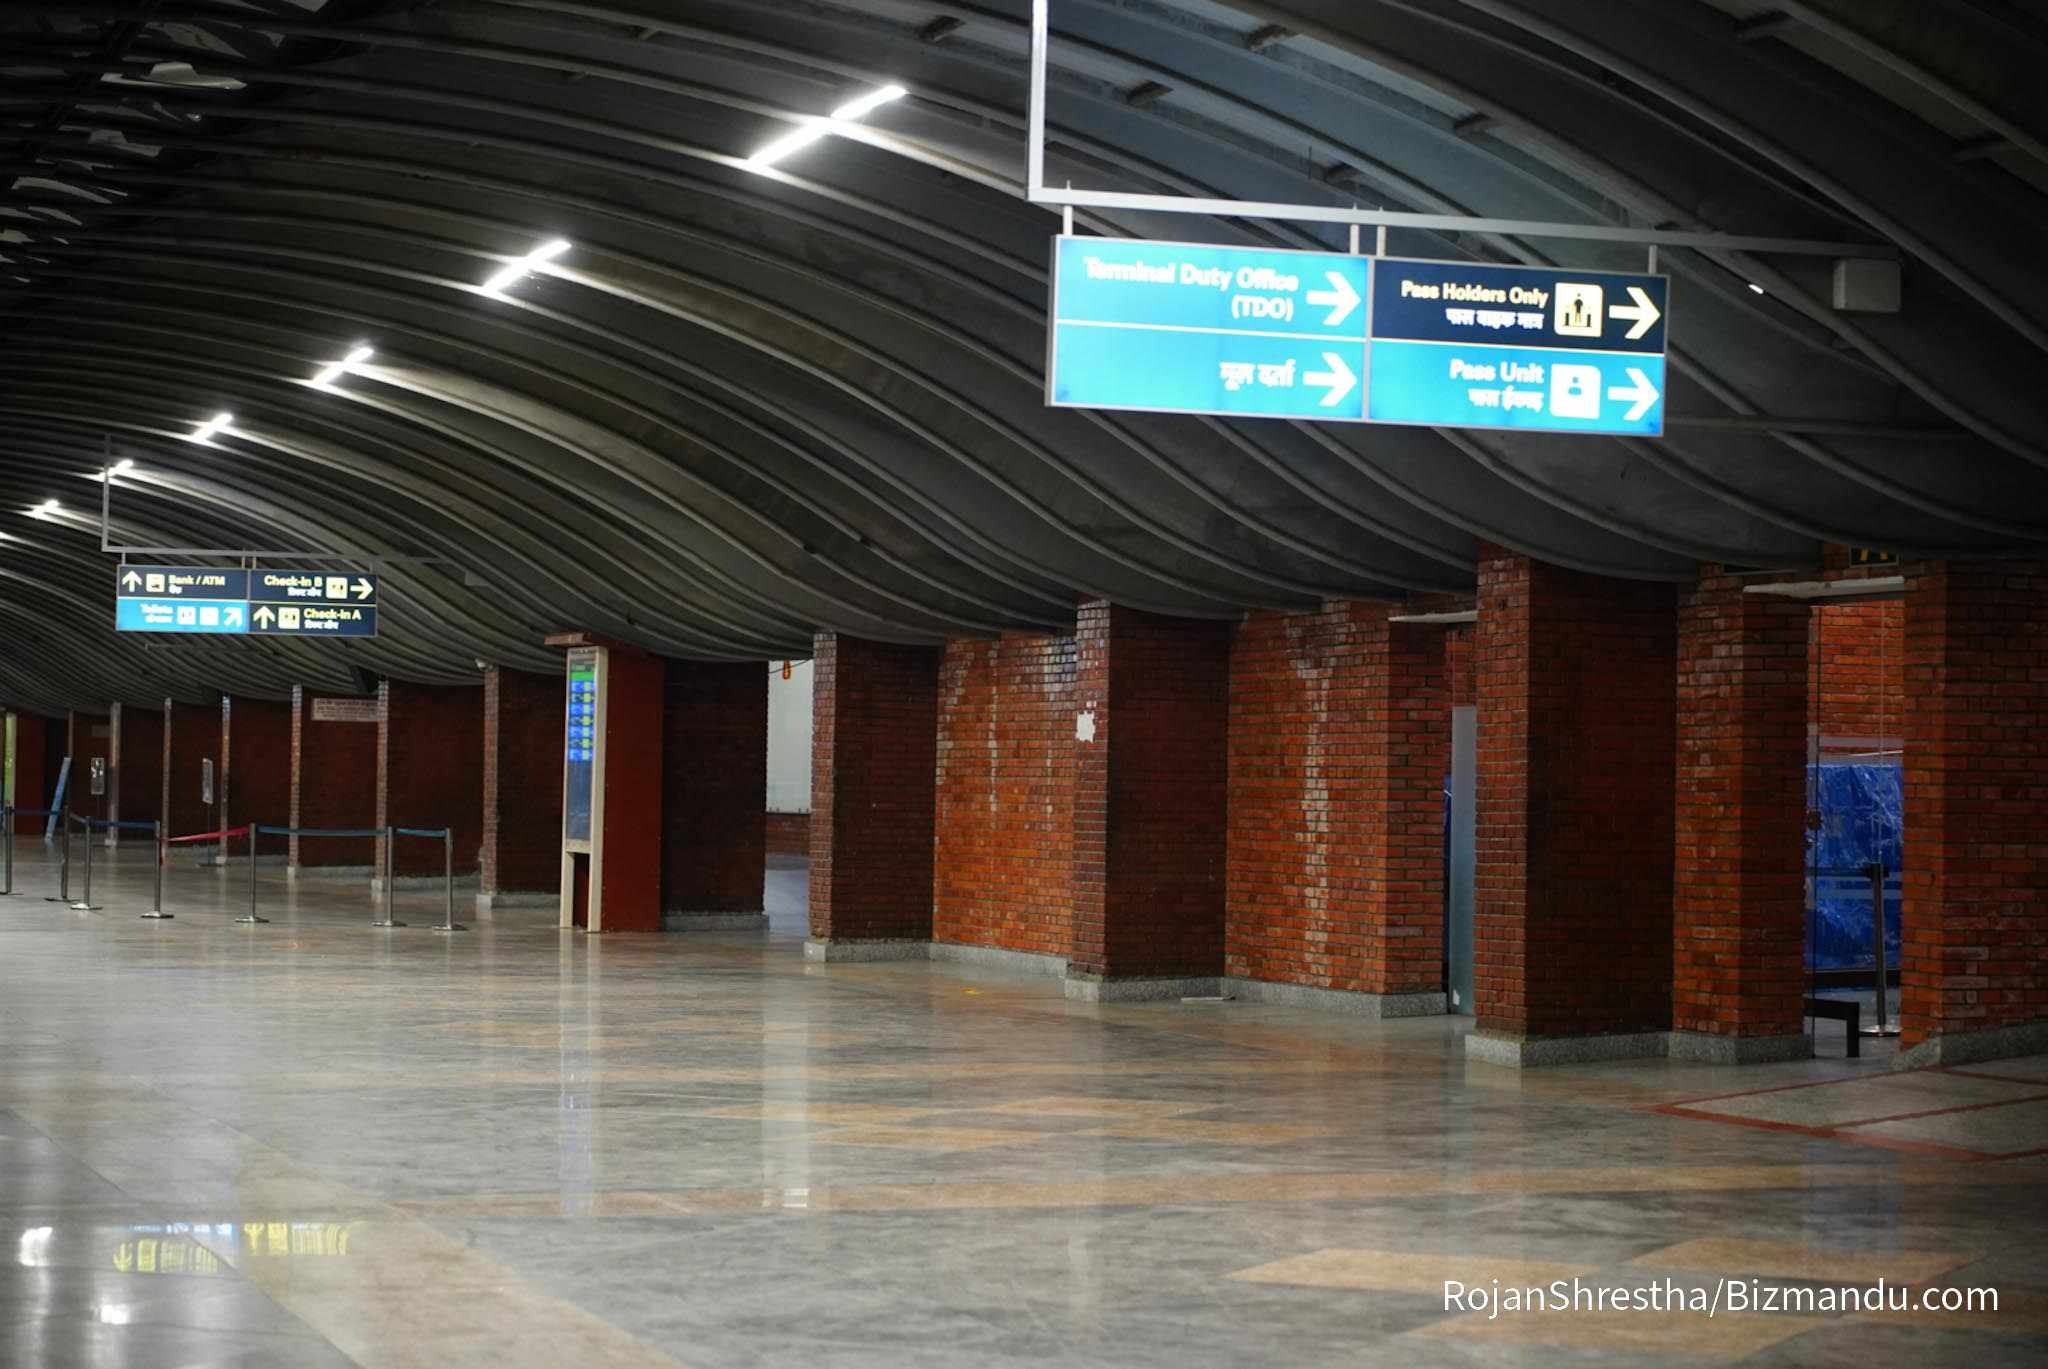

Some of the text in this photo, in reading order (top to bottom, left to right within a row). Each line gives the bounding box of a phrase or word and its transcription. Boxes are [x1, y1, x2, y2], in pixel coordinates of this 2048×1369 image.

[1082, 256, 1299, 291] Terminal Duty Office
[1401, 279, 1549, 309] Pass Holders Only
[1232, 294, 1294, 321] (TDO)
[1450, 358, 1544, 384] Pass Unit
[202, 575, 225, 586] ATM
[264, 575, 312, 587] Check-in
[304, 608, 362, 620] Check-in A
